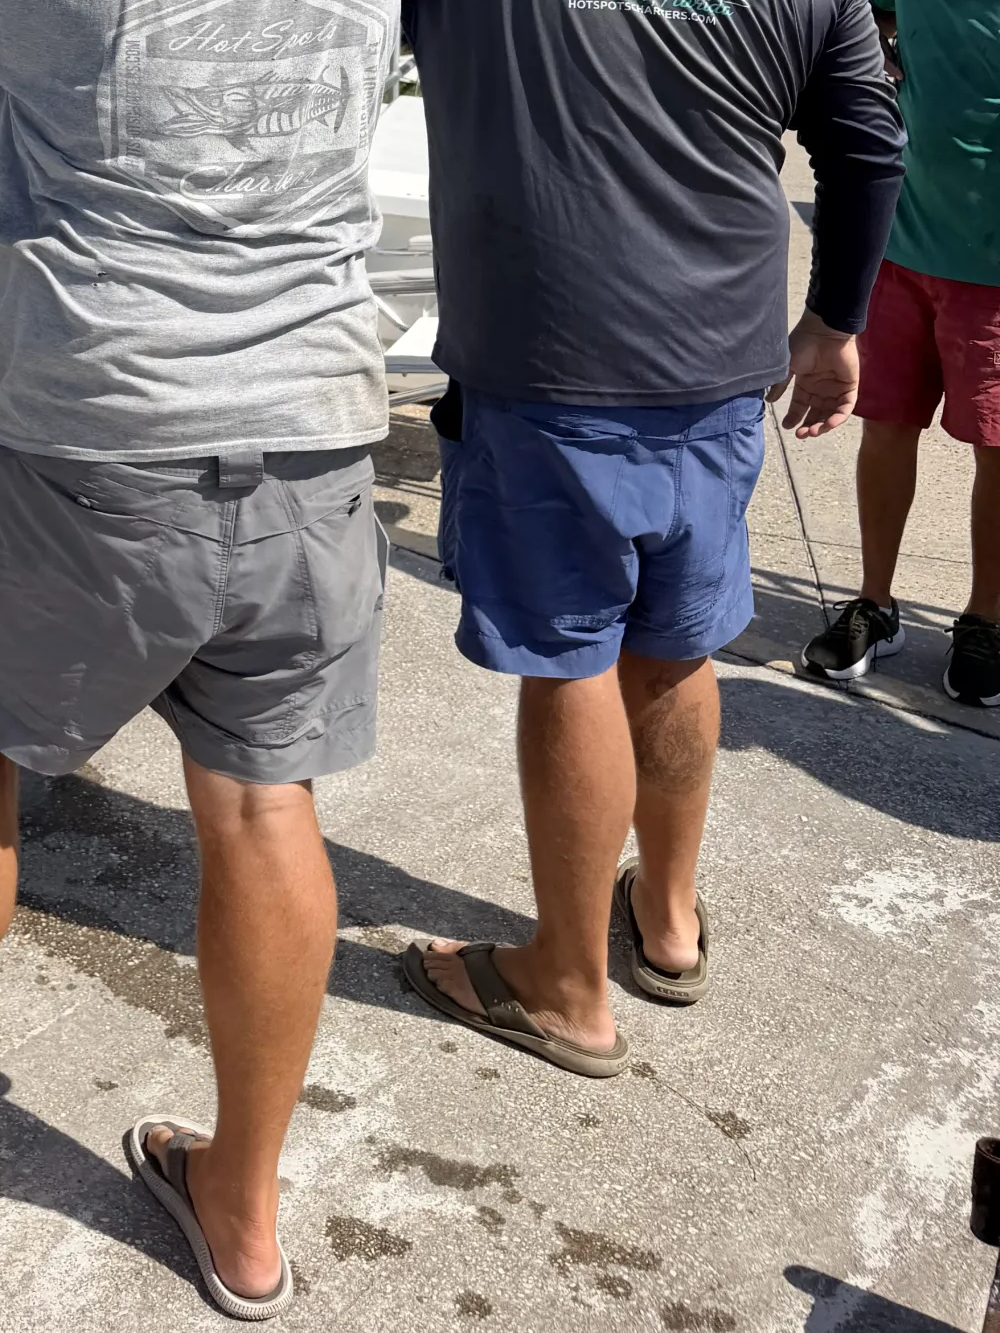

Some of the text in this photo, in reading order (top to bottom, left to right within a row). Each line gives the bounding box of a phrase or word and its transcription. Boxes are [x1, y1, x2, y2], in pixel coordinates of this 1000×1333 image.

[567, 0, 717, 27] HOTSPOTSCHARTERS.COM
[168, 18, 338, 61] Hot Spots
